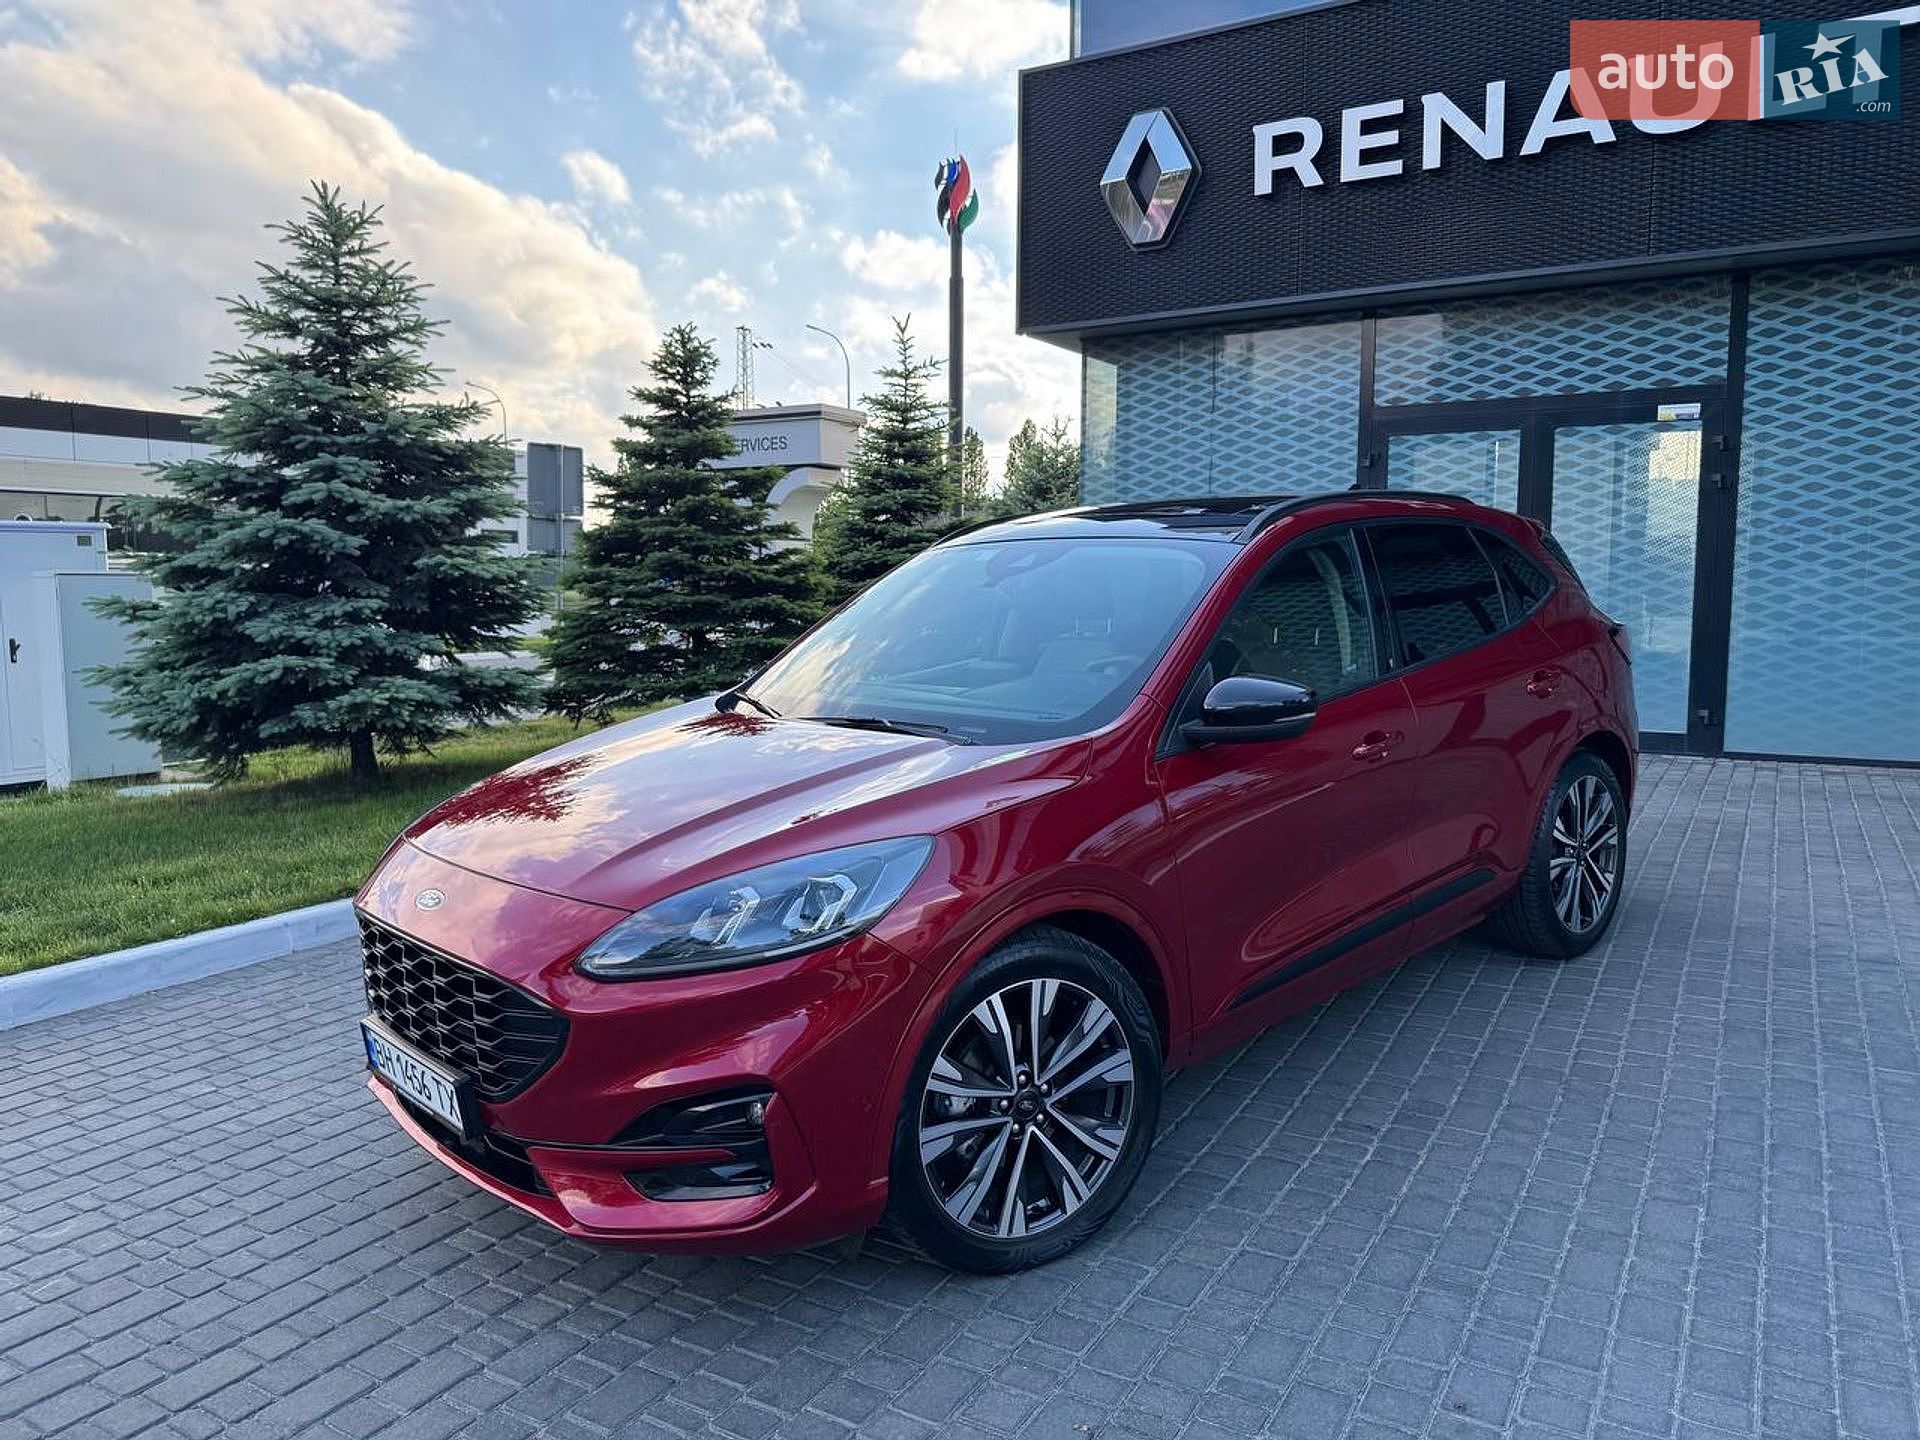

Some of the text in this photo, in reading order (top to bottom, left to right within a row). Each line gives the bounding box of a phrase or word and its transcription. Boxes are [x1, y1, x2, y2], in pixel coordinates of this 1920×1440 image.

[729, 436, 788, 451] ERVICES
[396, 1054, 432, 1101] 1456
[431, 1075, 462, 1121] TX
